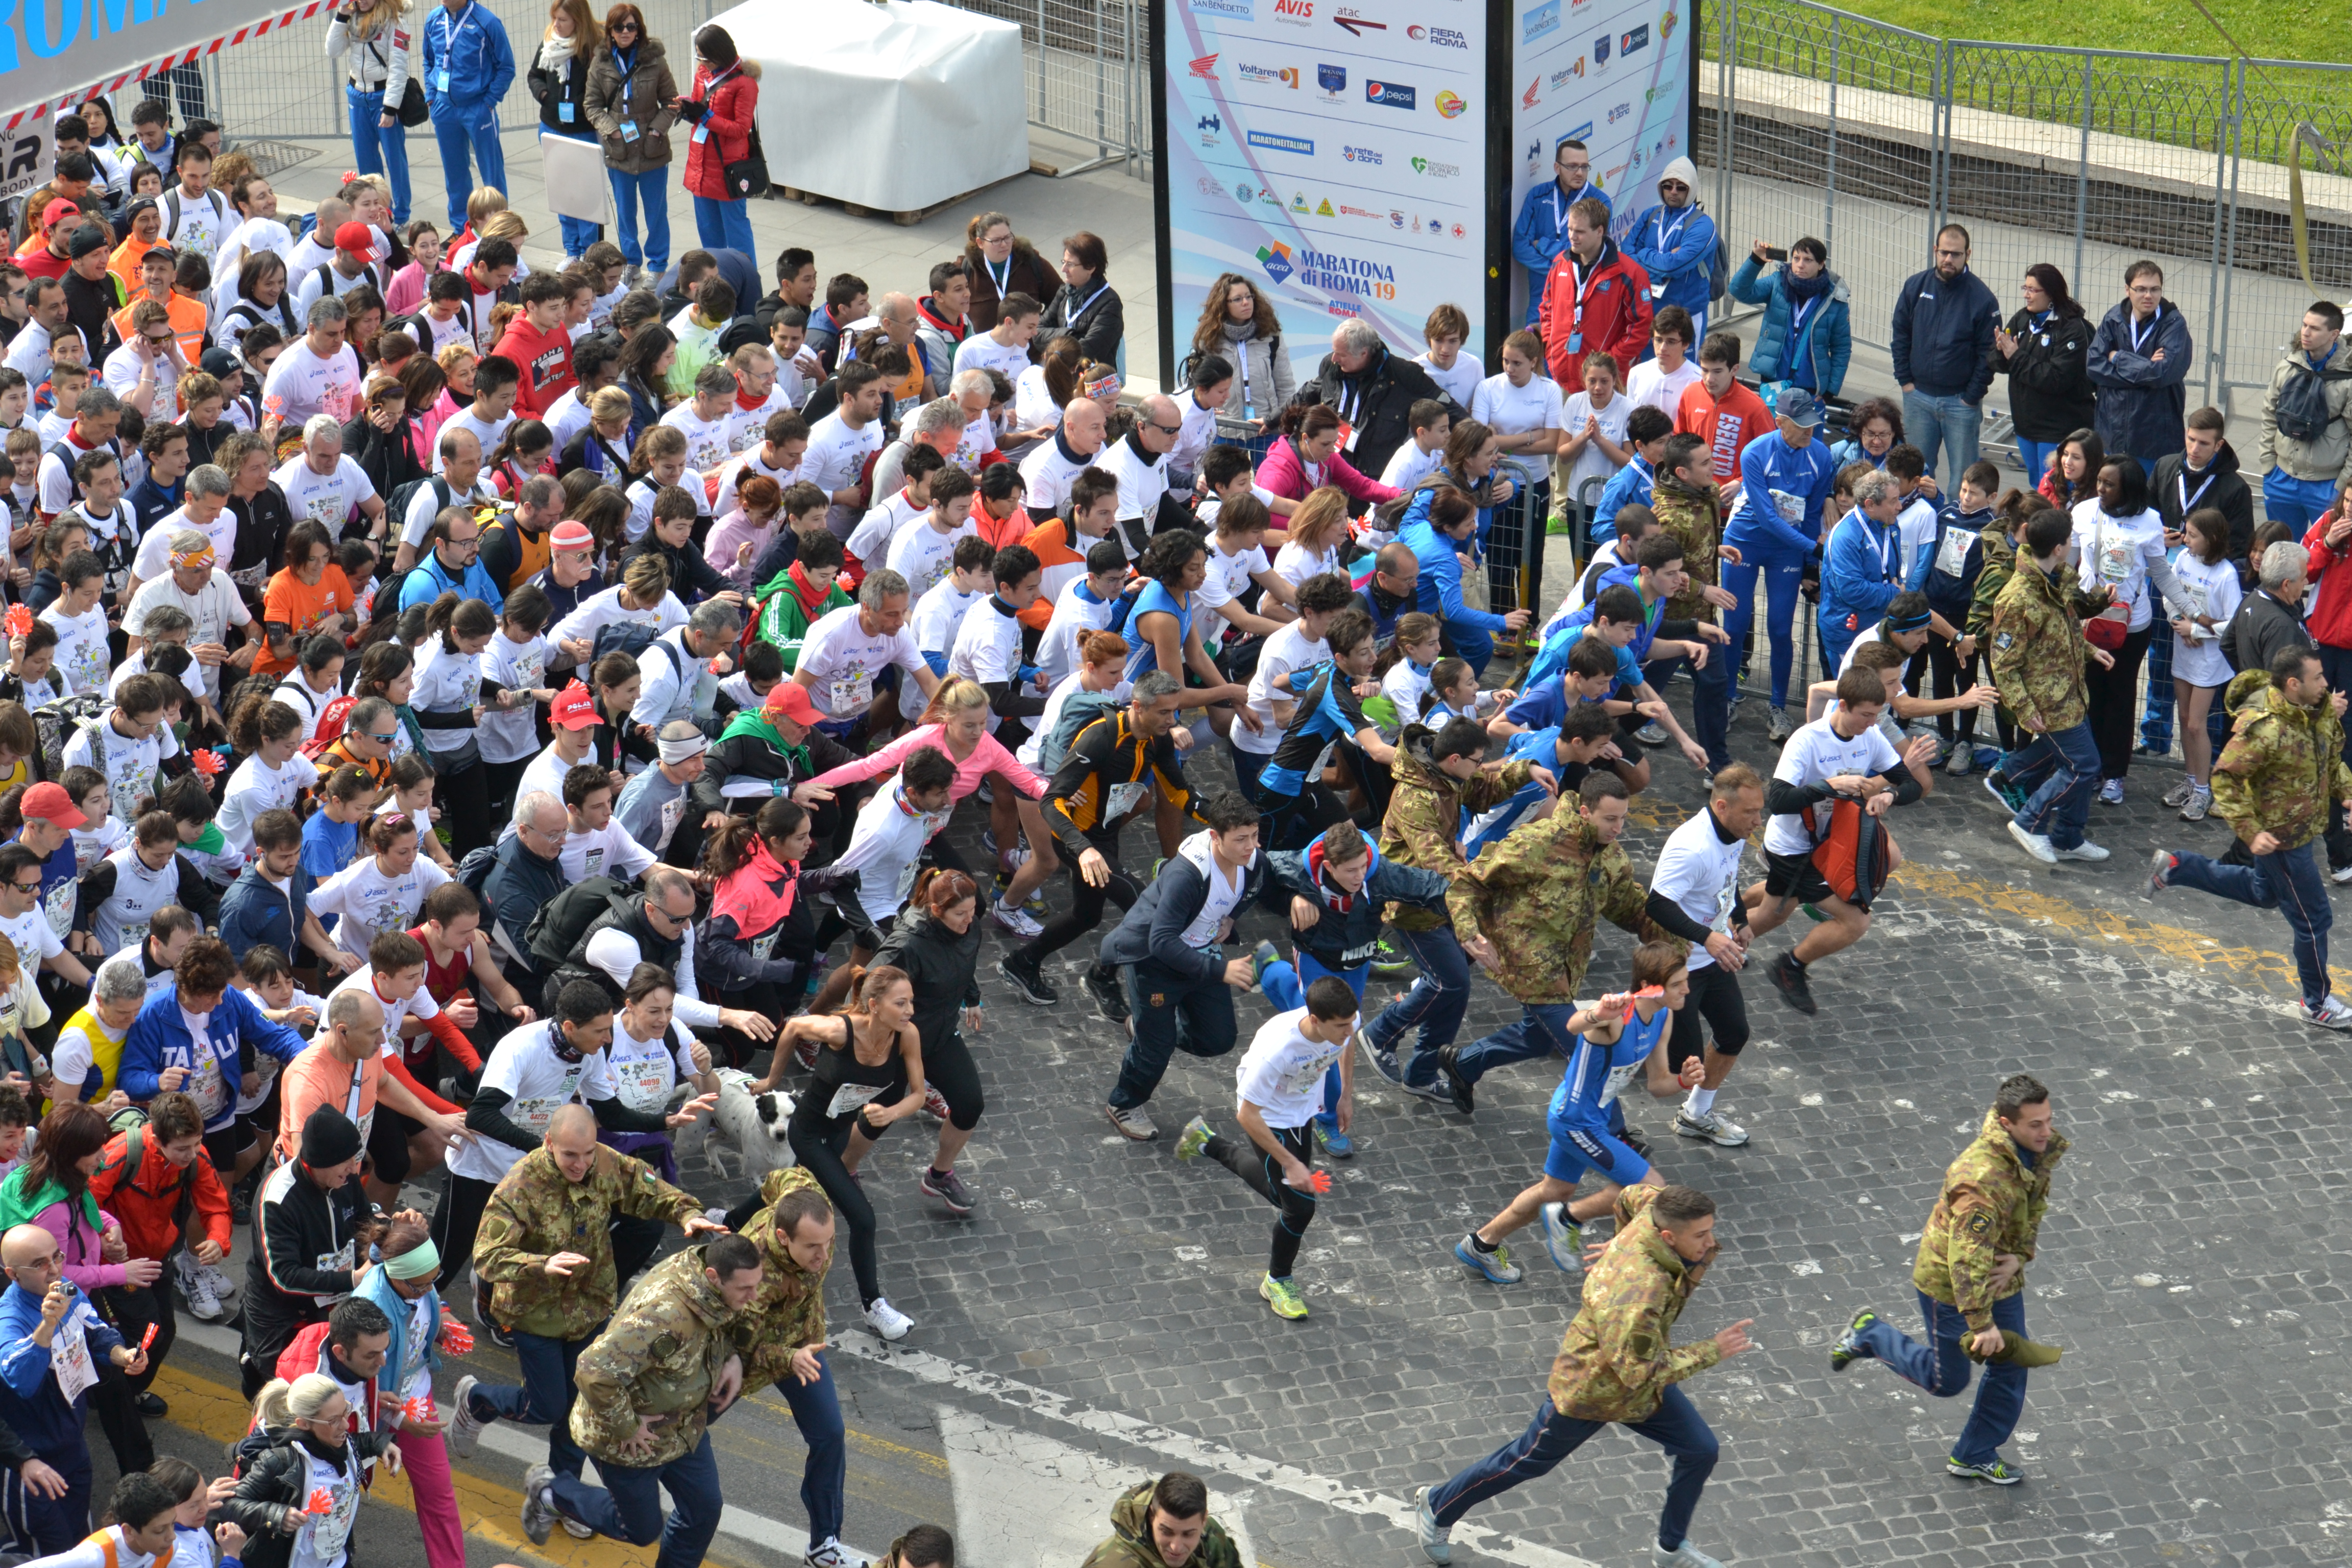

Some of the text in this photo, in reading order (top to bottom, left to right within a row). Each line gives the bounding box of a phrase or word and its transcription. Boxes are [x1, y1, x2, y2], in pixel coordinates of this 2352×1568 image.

[1207, 1, 1250, 15] BENEDETTO
[1274, 0, 1314, 17] AVIS
[1337, 6, 1360, 18] atac
[1275, 16, 1312, 28] Autonoleggio
[1534, 15, 1558, 33] BENEDETTO
[1430, 27, 1464, 40] FIERA
[1632, 30, 1647, 46] pepsi
[1430, 35, 1468, 50] ROMA
[1188, 71, 1220, 81] HONDA
[1238, 63, 1279, 79] Voltaren
[1551, 67, 1573, 84] Voltaren
[1386, 90, 1412, 103] pepsi
[1442, 100, 1462, 109] Lipton
[1523, 98, 1541, 111] HONDA
[1250, 134, 1311, 152] MARATONEITALIANE
[1354, 147, 1383, 159] rete del
[1357, 154, 1382, 165] dono
[1428, 161, 1460, 171] FONDAZIONE
[1428, 166, 1460, 177] BIOPARCO
[0, 175, 36, 198] BODY
[1610, 208, 1636, 238] TONA
[1266, 260, 1290, 274] acea
[1300, 249, 1395, 283] MARATONA
[1300, 269, 1396, 301] di ROMA 19
[1328, 306, 1357, 318] ROMA
[1329, 299, 1362, 313] ATIELLE
[532, 347, 564, 367] PRAHA
[534, 370, 566, 393] DRINKING TEAM
[1713, 412, 1742, 477] ESERCITO
[568, 701, 591, 712] POLAR
[1342, 944, 1378, 962] NIKE
[640, 1078, 660, 1087] 44099
[204, 1085, 216, 1095] 1187
[318, 1467, 335, 1477] asics
